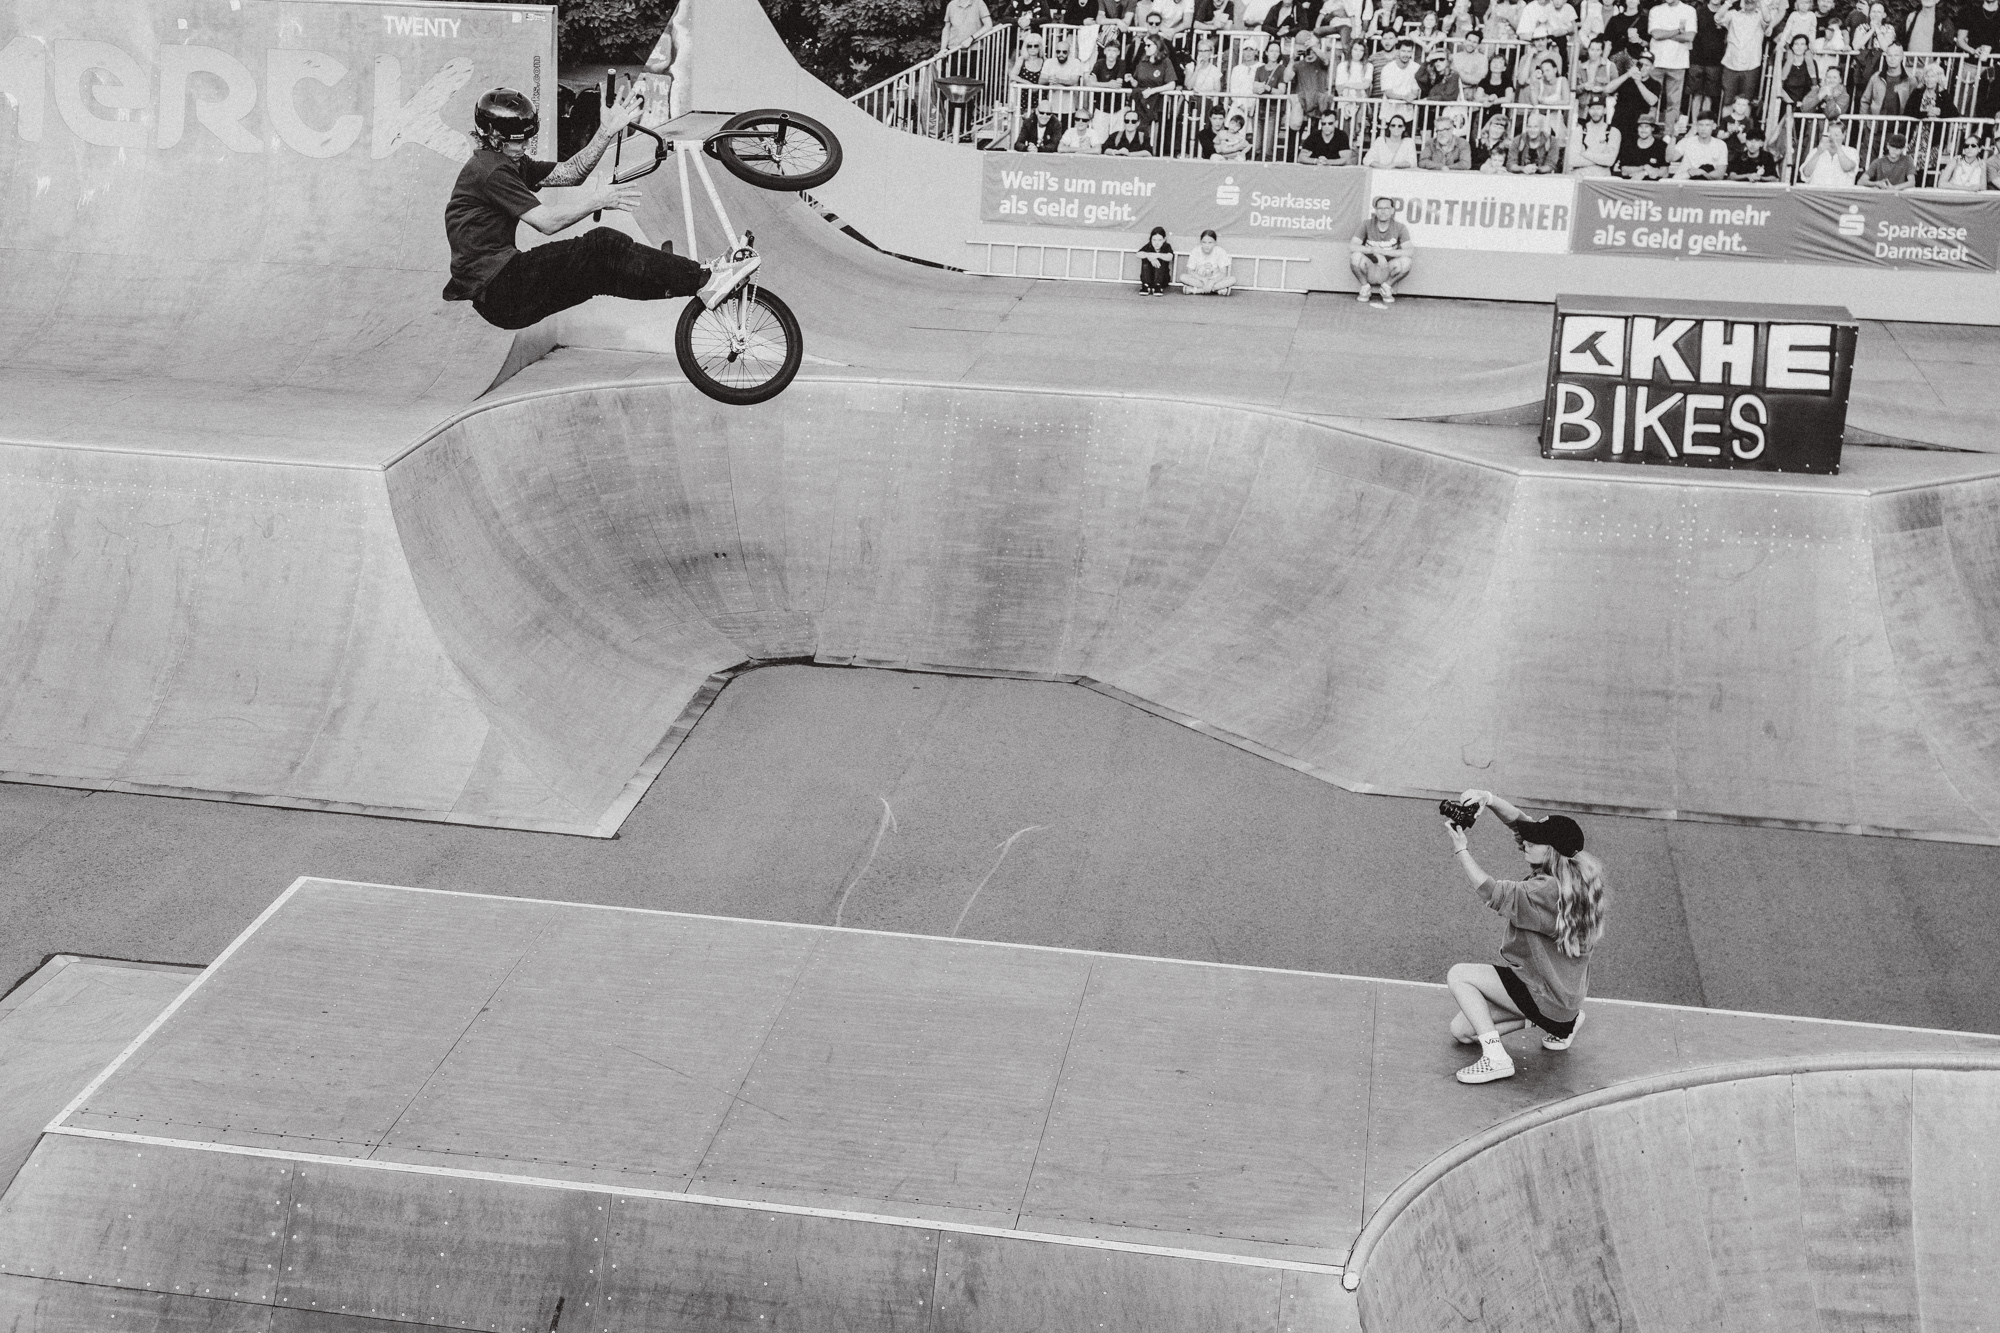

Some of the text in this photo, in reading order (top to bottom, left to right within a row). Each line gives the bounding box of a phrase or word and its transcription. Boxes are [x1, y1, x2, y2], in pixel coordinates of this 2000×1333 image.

[383, 15, 461, 38] TWENTY
[1064, 178, 1096, 194] um
[1101, 176, 1156, 197] mehr
[999, 194, 1136, 224] als Geld geht.
[1251, 191, 1331, 211] Sparkasse
[1250, 212, 1333, 230] Darmstadt
[1668, 206, 1703, 224] um
[1709, 204, 1771, 226] mehr
[1593, 224, 1748, 255] als Geld geht.
[1877, 220, 1967, 241] Sparkasse
[1875, 242, 1969, 262] Darmstadt
[1630, 316, 1832, 391] KHE
[1551, 382, 1768, 460] BIKES
